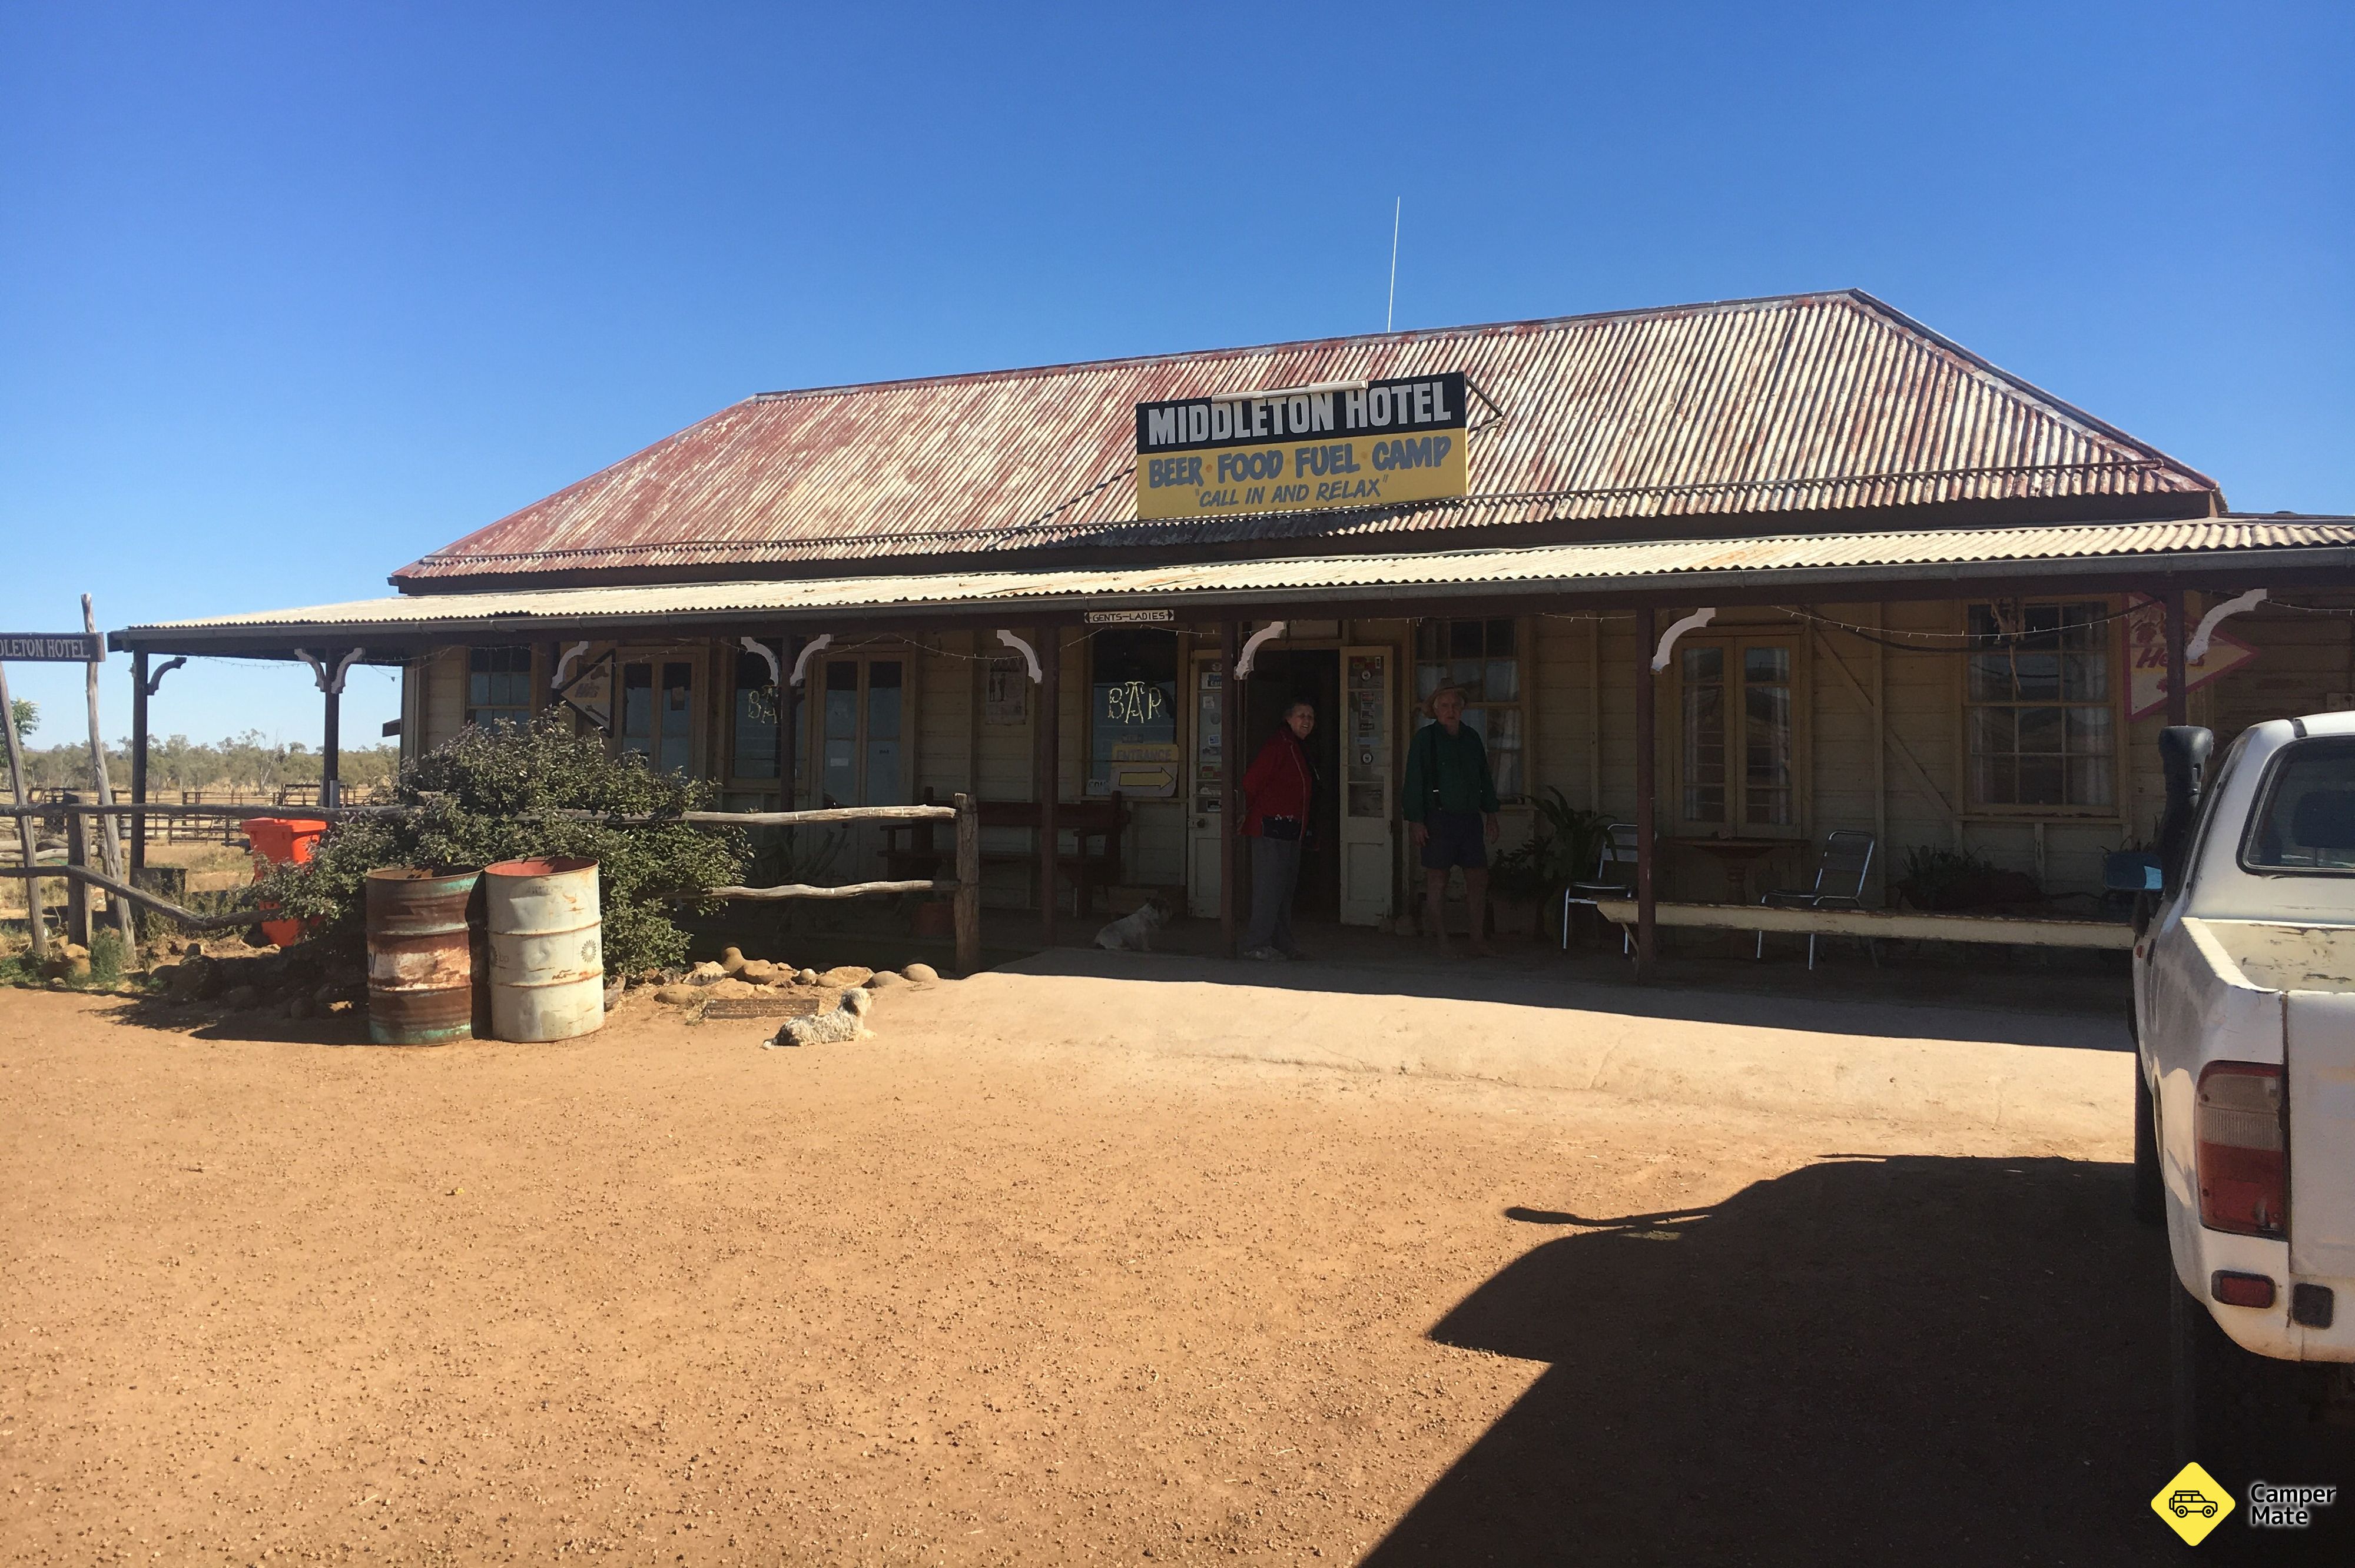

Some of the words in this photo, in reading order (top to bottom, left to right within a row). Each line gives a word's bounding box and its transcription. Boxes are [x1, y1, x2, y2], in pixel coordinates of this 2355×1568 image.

[1148, 393, 1334, 446] MIDDLETON
[1346, 381, 1451, 429] HOTEL
[1149, 456, 1204, 489] BEER
[1218, 450, 1283, 483] FOOD
[1295, 443, 1360, 479] FUEL
[1372, 436, 1452, 471] CAMP
[1245, 487, 1265, 505] IN
[1271, 483, 1310, 503] AND
[47, 639, 90, 659] HOTEL
[748, 685, 782, 724] BA
[1107, 681, 1162, 724] BAR
